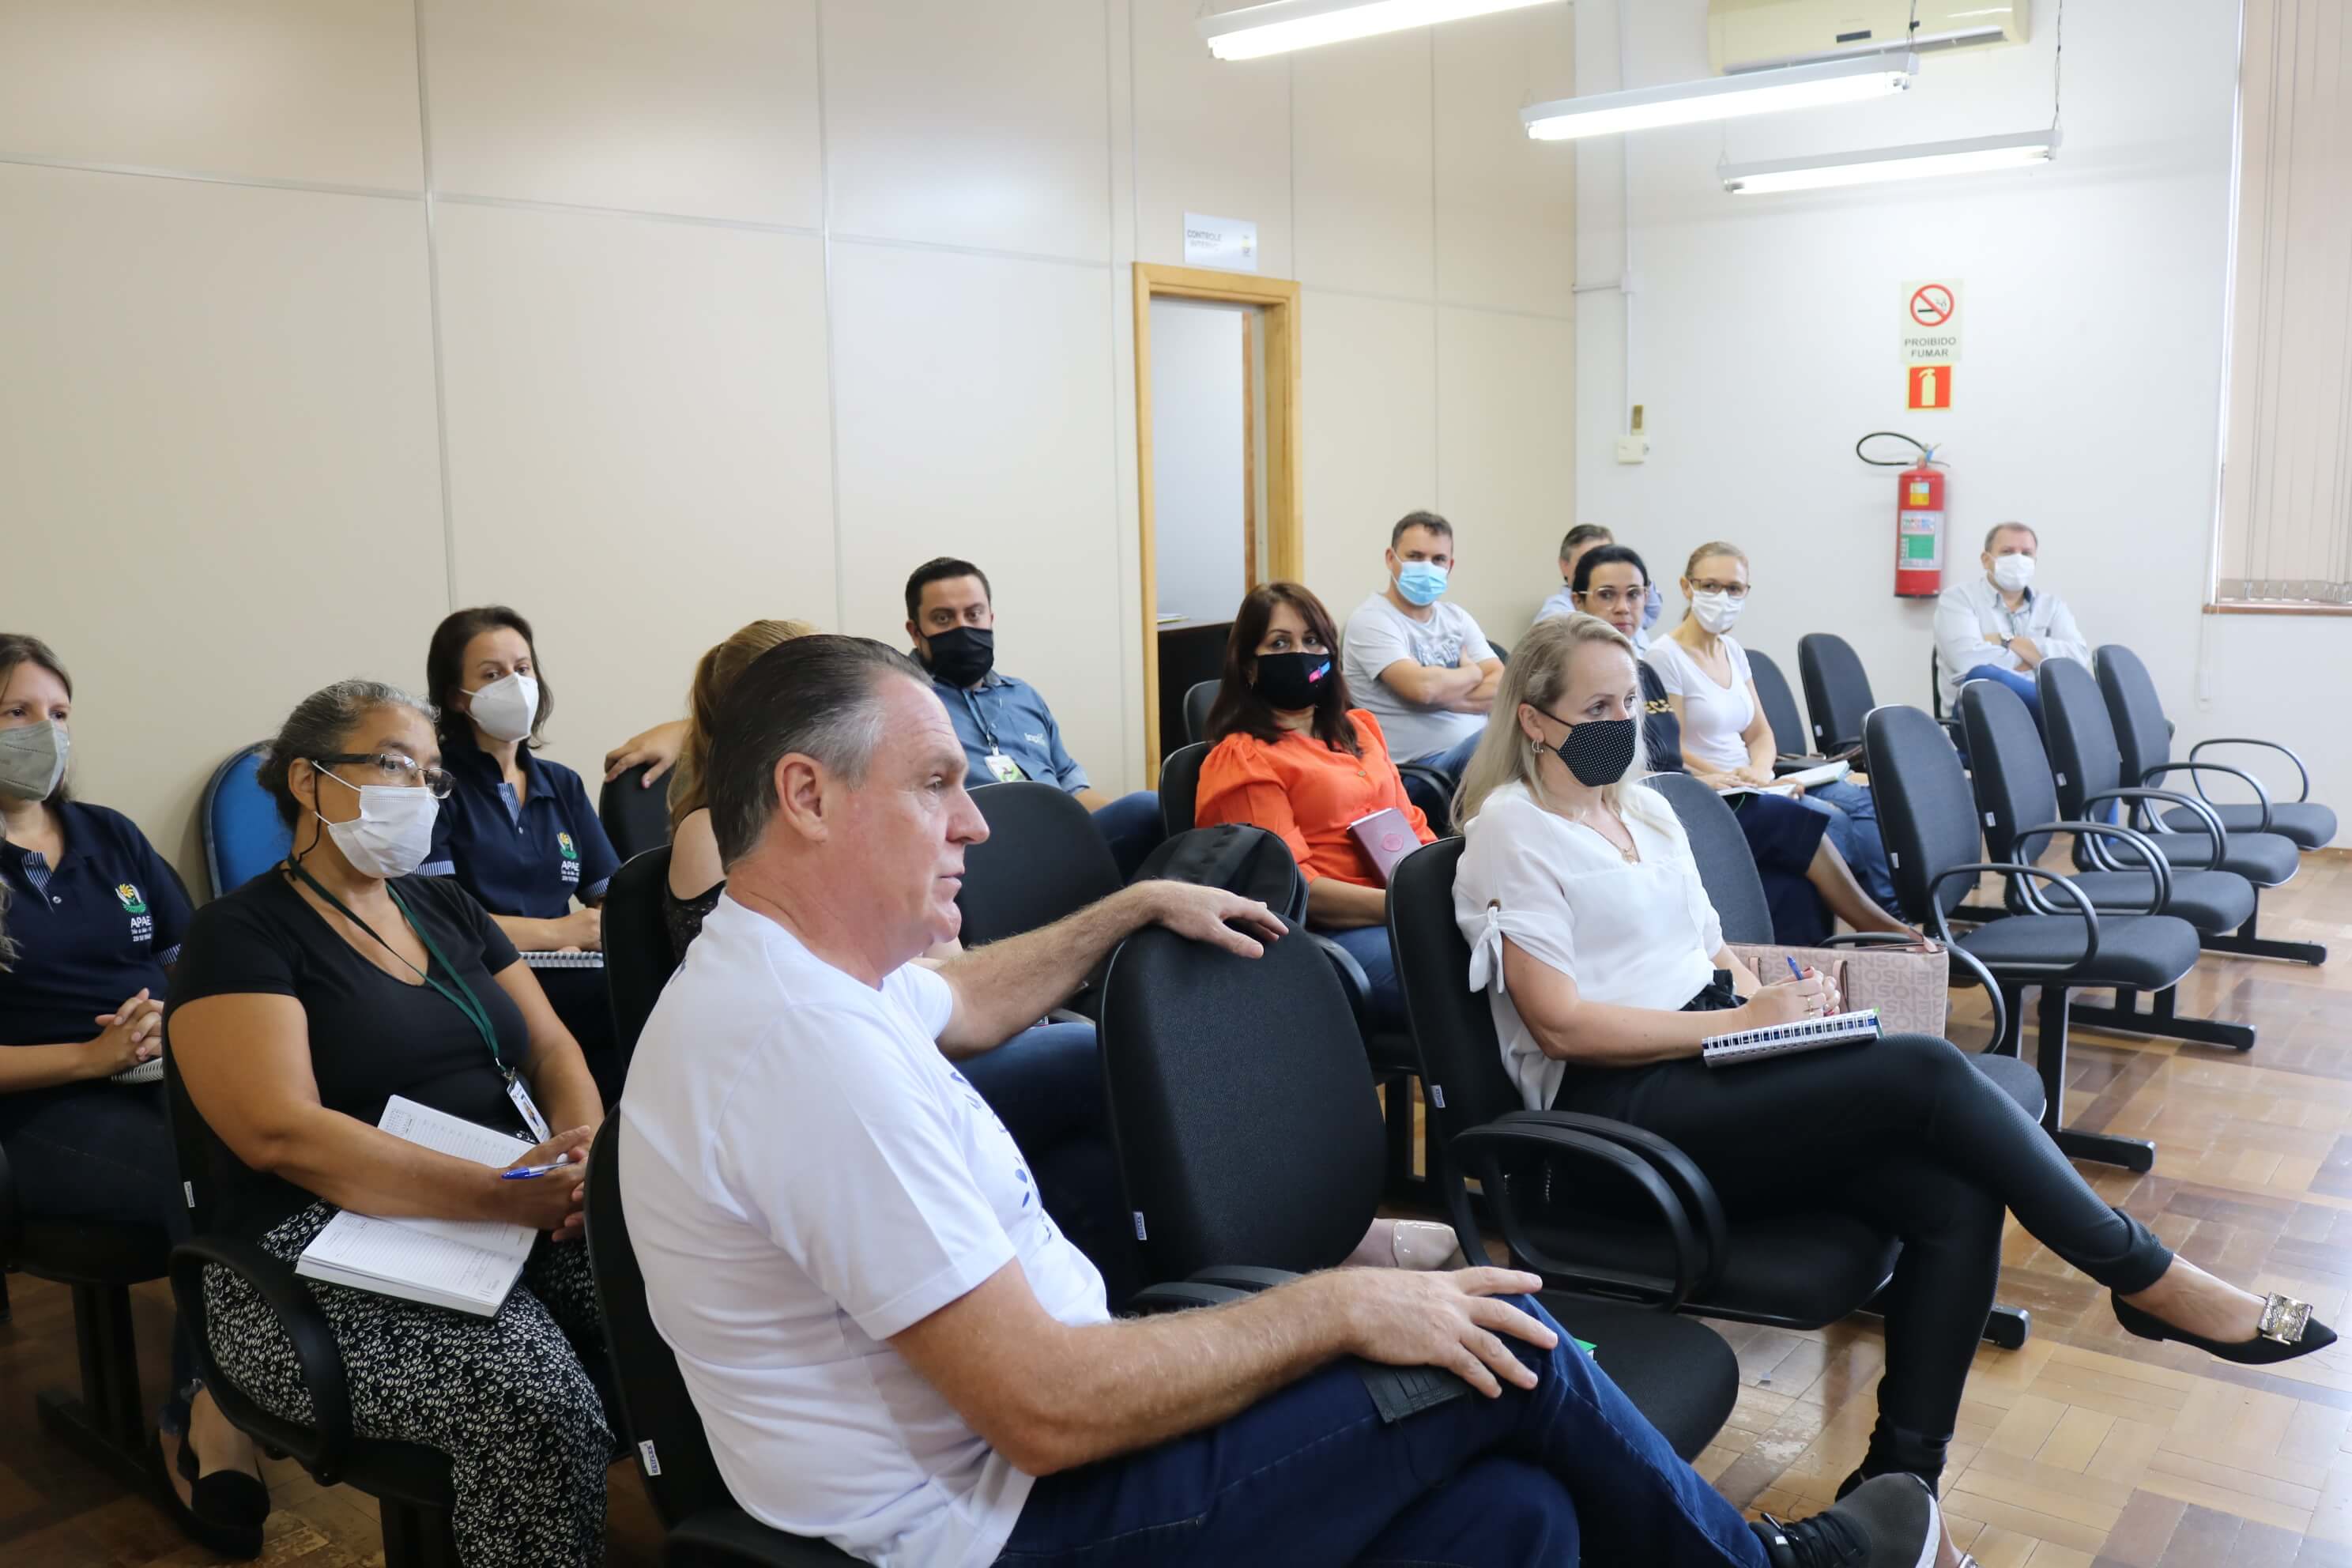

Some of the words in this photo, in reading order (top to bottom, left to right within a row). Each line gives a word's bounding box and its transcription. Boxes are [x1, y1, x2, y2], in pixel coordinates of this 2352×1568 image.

[1904, 337, 1957, 348] PROIBIDO
[1911, 349, 1950, 358] FUMAR
[560, 861, 580, 872] APAE
[130, 915, 152, 929] APAE
